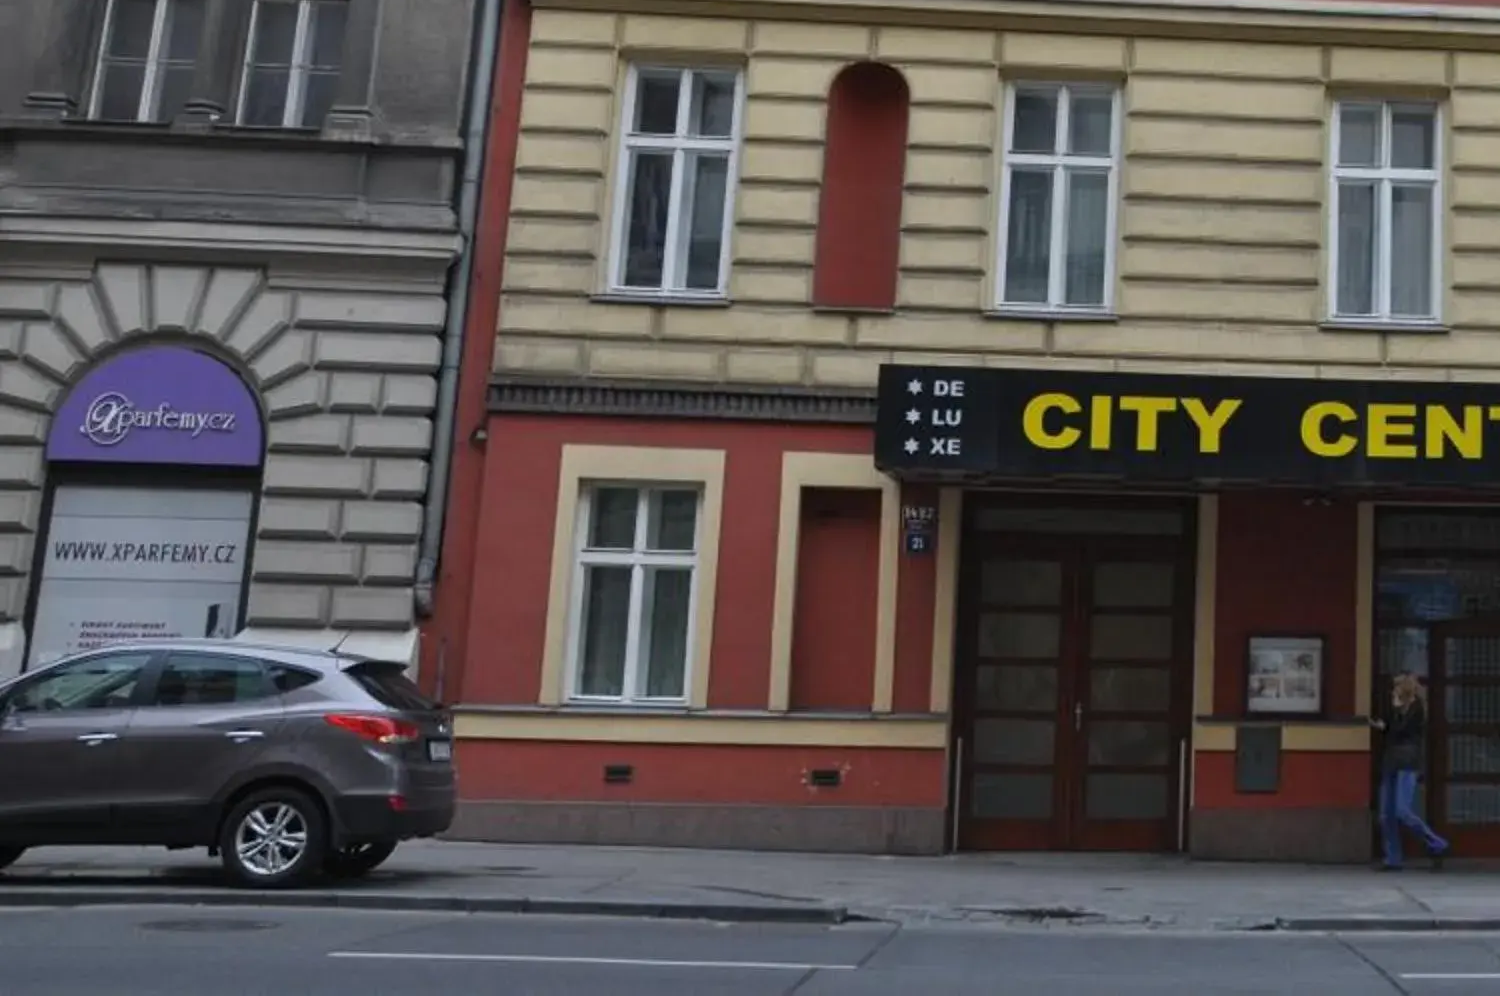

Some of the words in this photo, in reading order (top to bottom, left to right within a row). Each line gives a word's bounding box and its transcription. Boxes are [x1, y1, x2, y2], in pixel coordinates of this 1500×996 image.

[933, 380, 965, 397] DE
[931, 409, 962, 426] LU
[1022, 392, 1243, 454] CITY
[929, 438, 962, 456] XE
[55, 541, 237, 564] WWW.XPARFEMY.CZ
